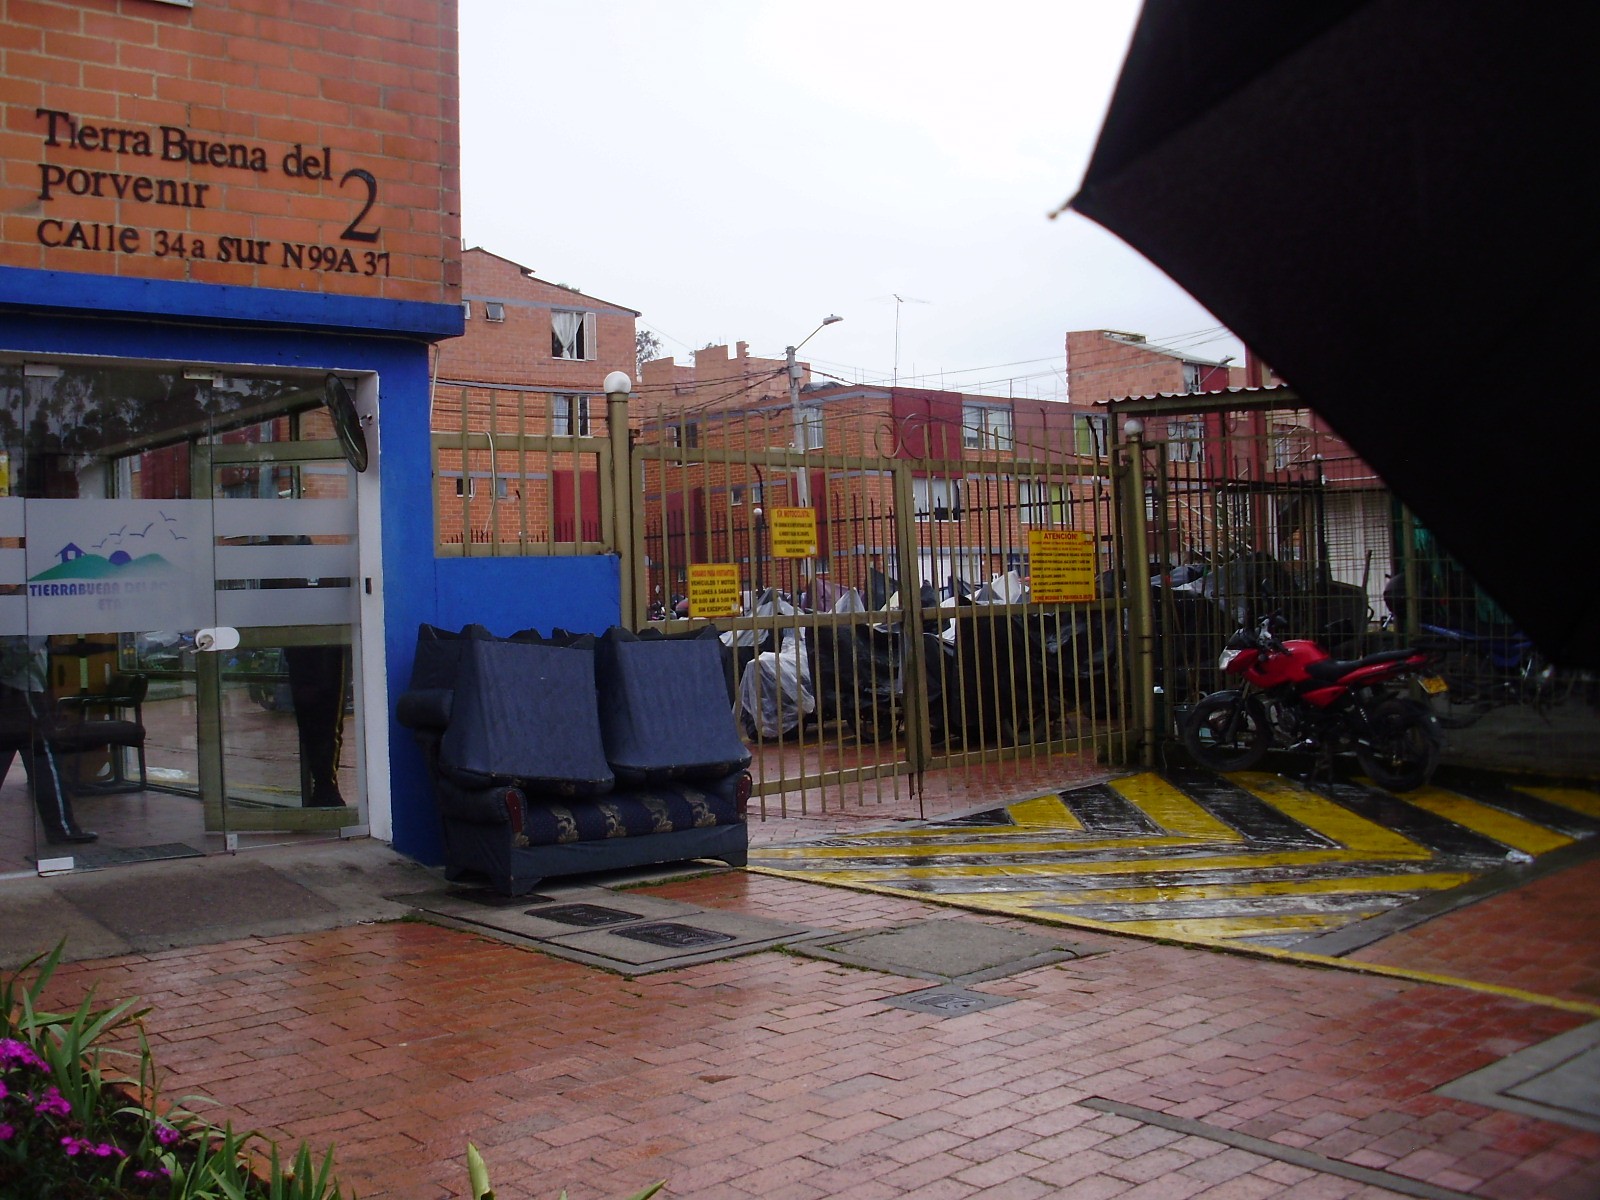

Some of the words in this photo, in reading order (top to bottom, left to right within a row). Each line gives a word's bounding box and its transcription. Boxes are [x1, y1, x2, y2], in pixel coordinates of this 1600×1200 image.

[36, 108, 153, 156] Tierra
[160, 126, 268, 172] Buena
[282, 144, 333, 181] del
[38, 163, 210, 209] Porvenir
[340, 168, 381, 243] 2
[218, 236, 271, 265] sur
[364, 251, 390, 277] 37
[29, 582, 120, 597] TIERRABUENA
